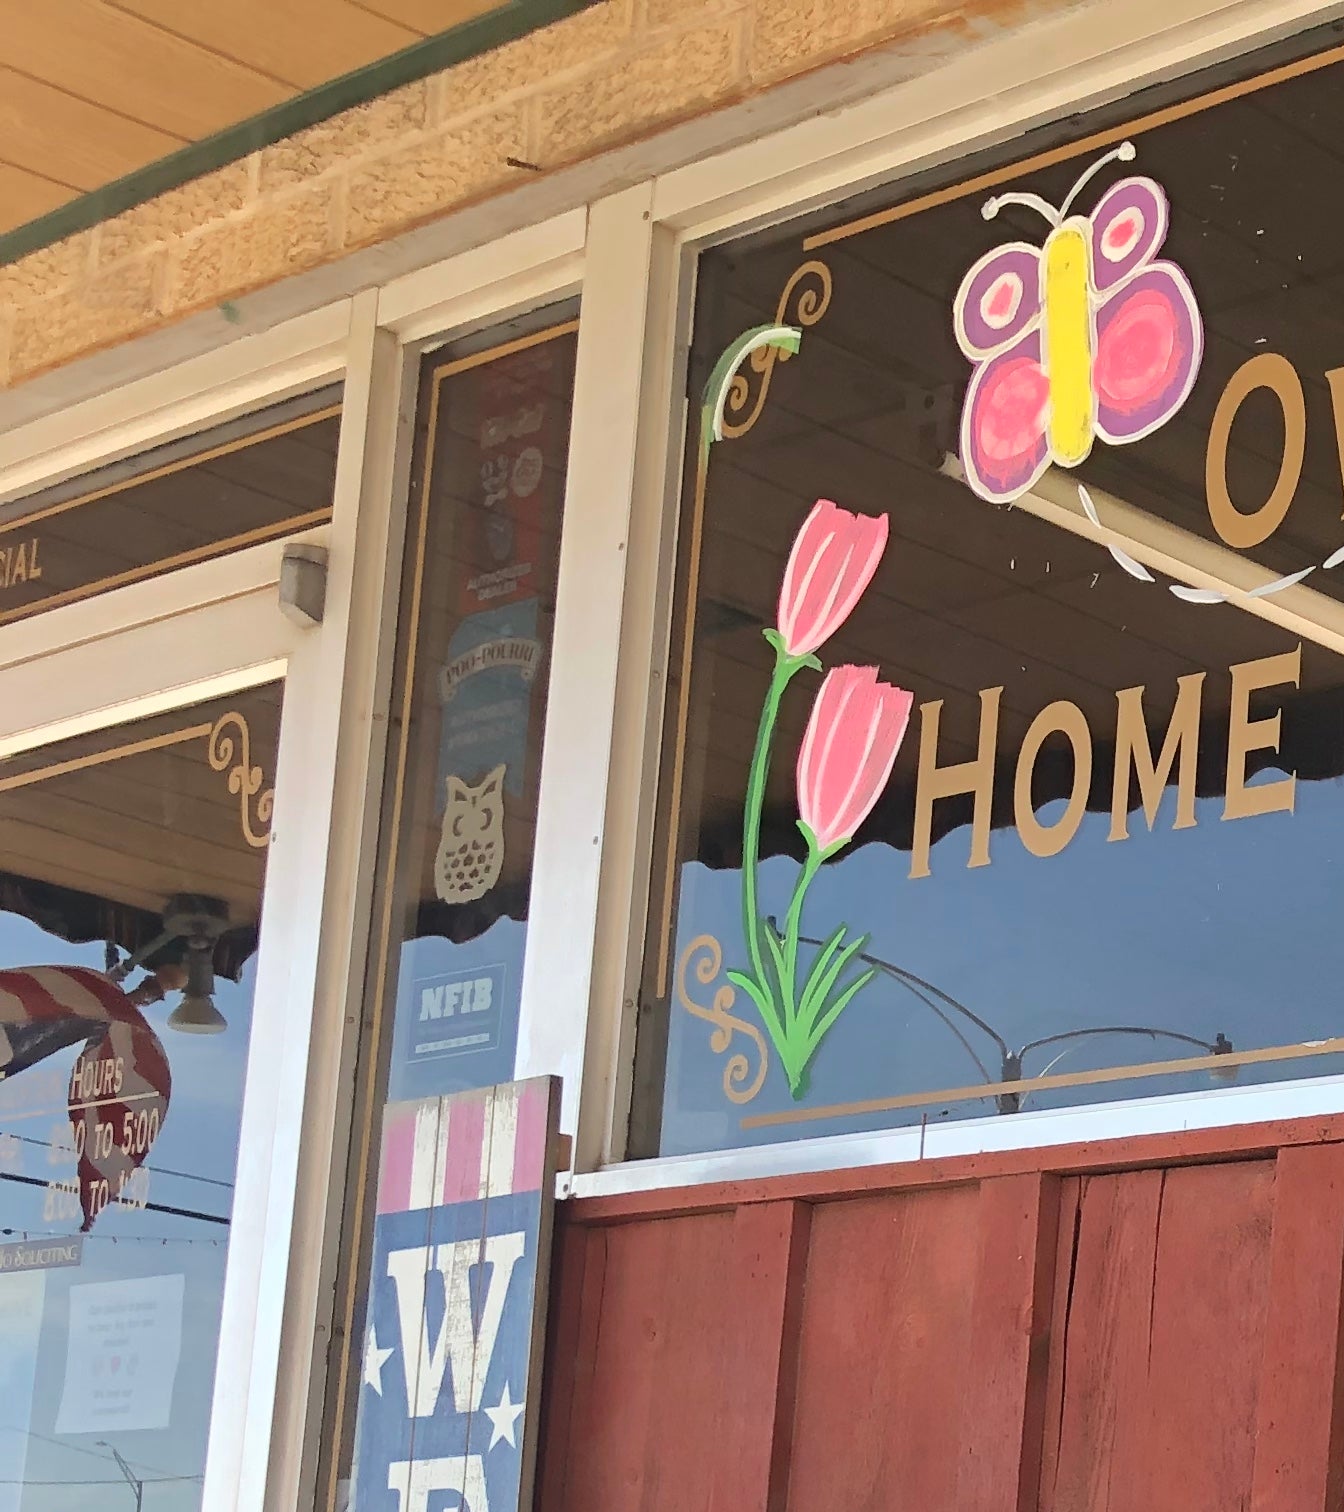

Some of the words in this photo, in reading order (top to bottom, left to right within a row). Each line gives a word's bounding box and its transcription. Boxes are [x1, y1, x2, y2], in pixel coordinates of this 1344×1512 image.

[908, 642, 1302, 879] HOME
[418, 976, 493, 1021] NFIB
[70, 1056, 124, 1099] HOURS
[95, 1122, 114, 1159] TO
[122, 1107, 159, 1156] 5:00
[89, 1179, 109, 1217] TO
